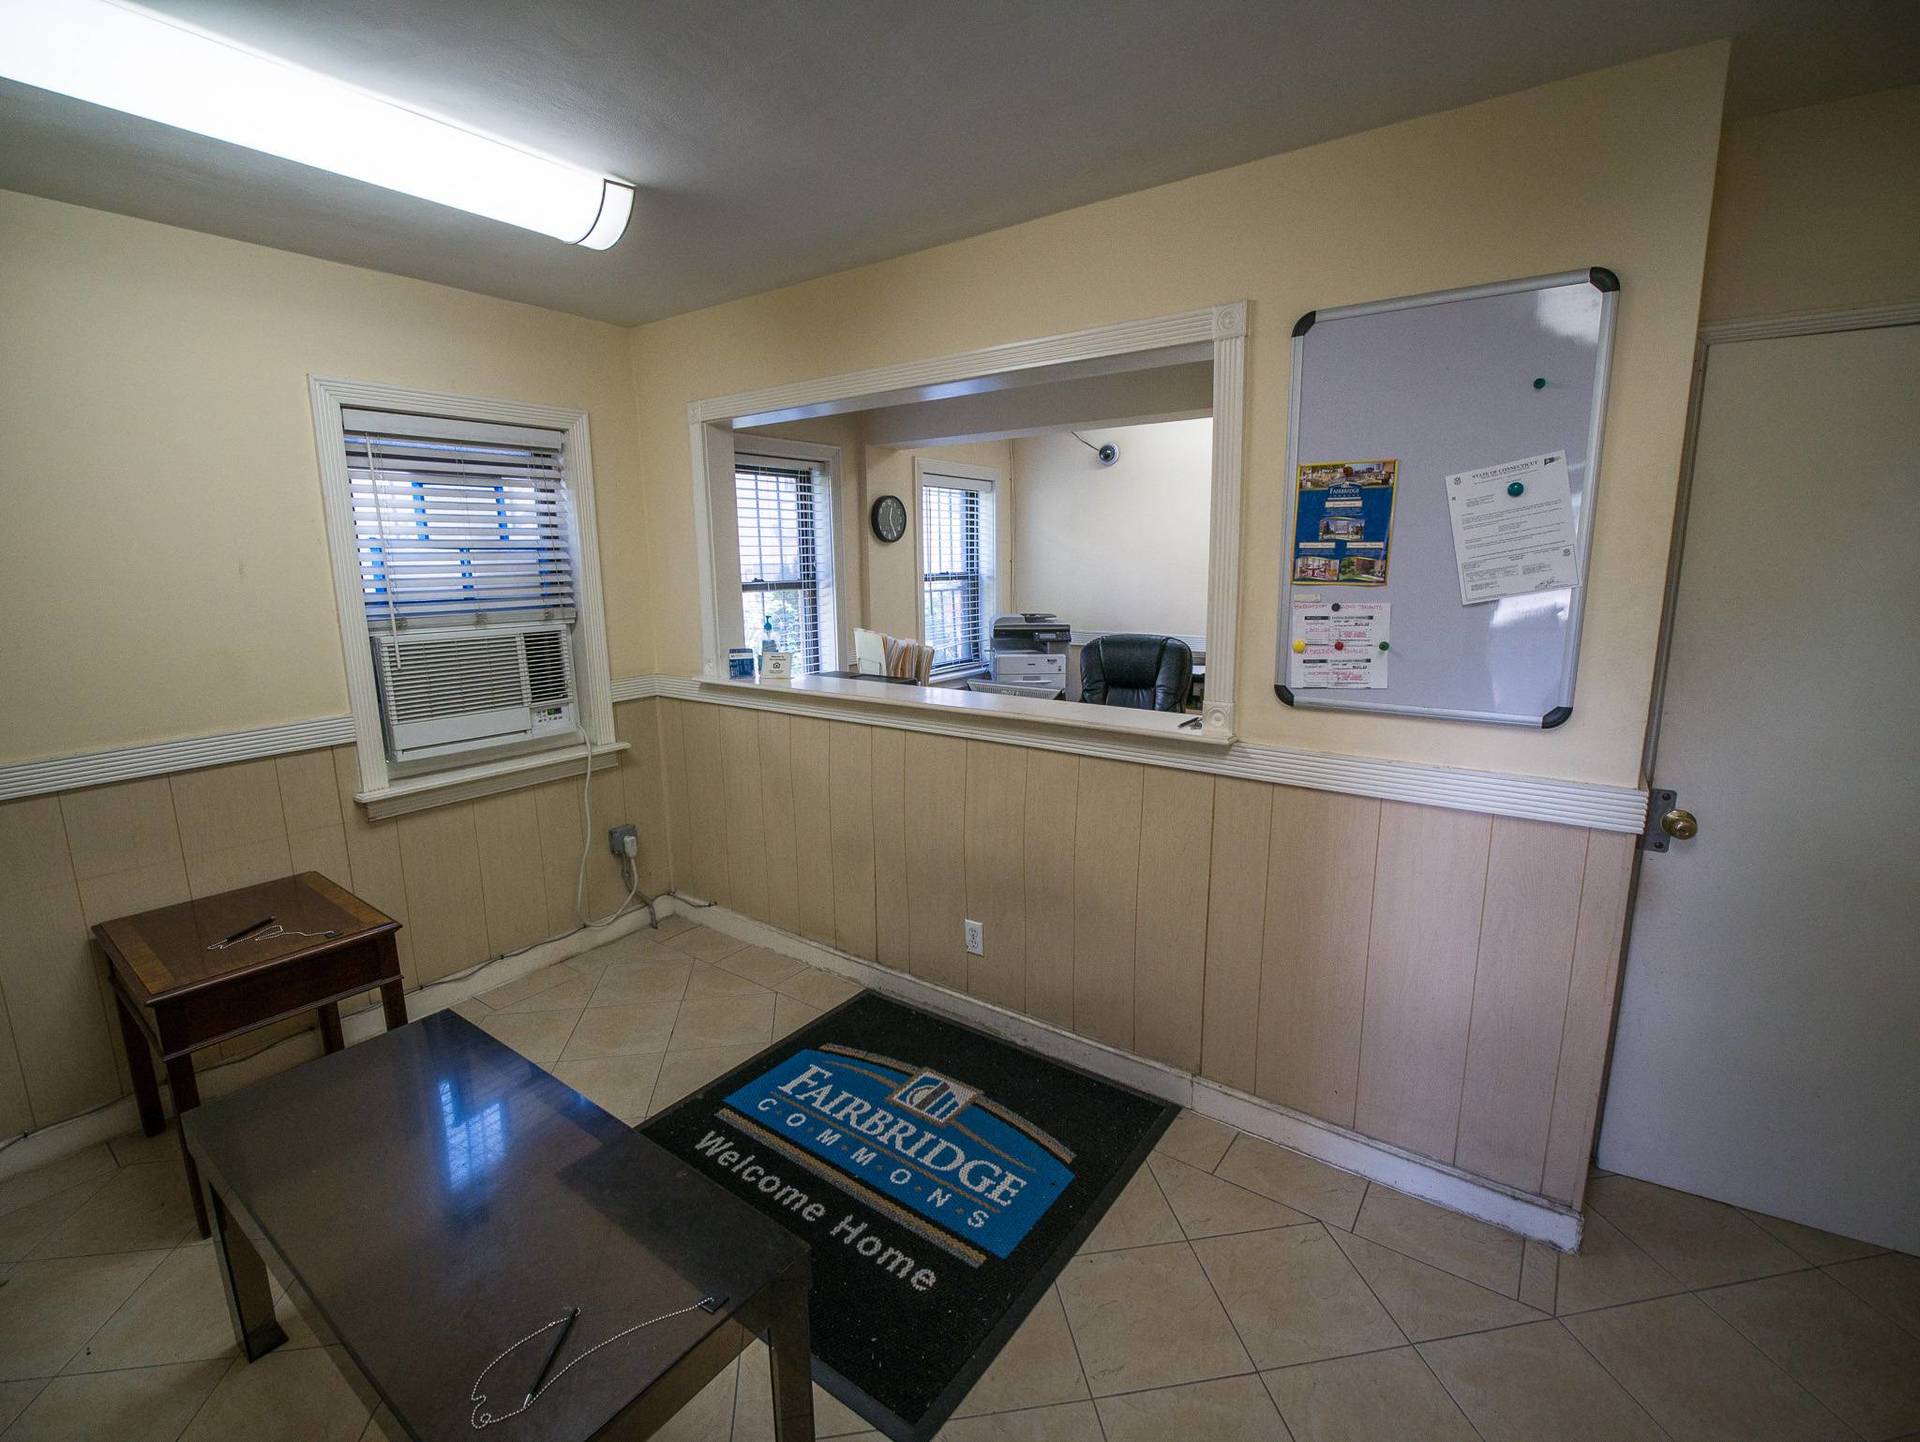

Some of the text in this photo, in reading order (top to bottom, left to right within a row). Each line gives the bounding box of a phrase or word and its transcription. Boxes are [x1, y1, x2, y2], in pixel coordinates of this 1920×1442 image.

[1498, 460, 1538, 473] CONNECTICUT
[778, 1064, 1029, 1207] FAIRBRIDGE
[693, 1130, 938, 1292] Welcome Home
